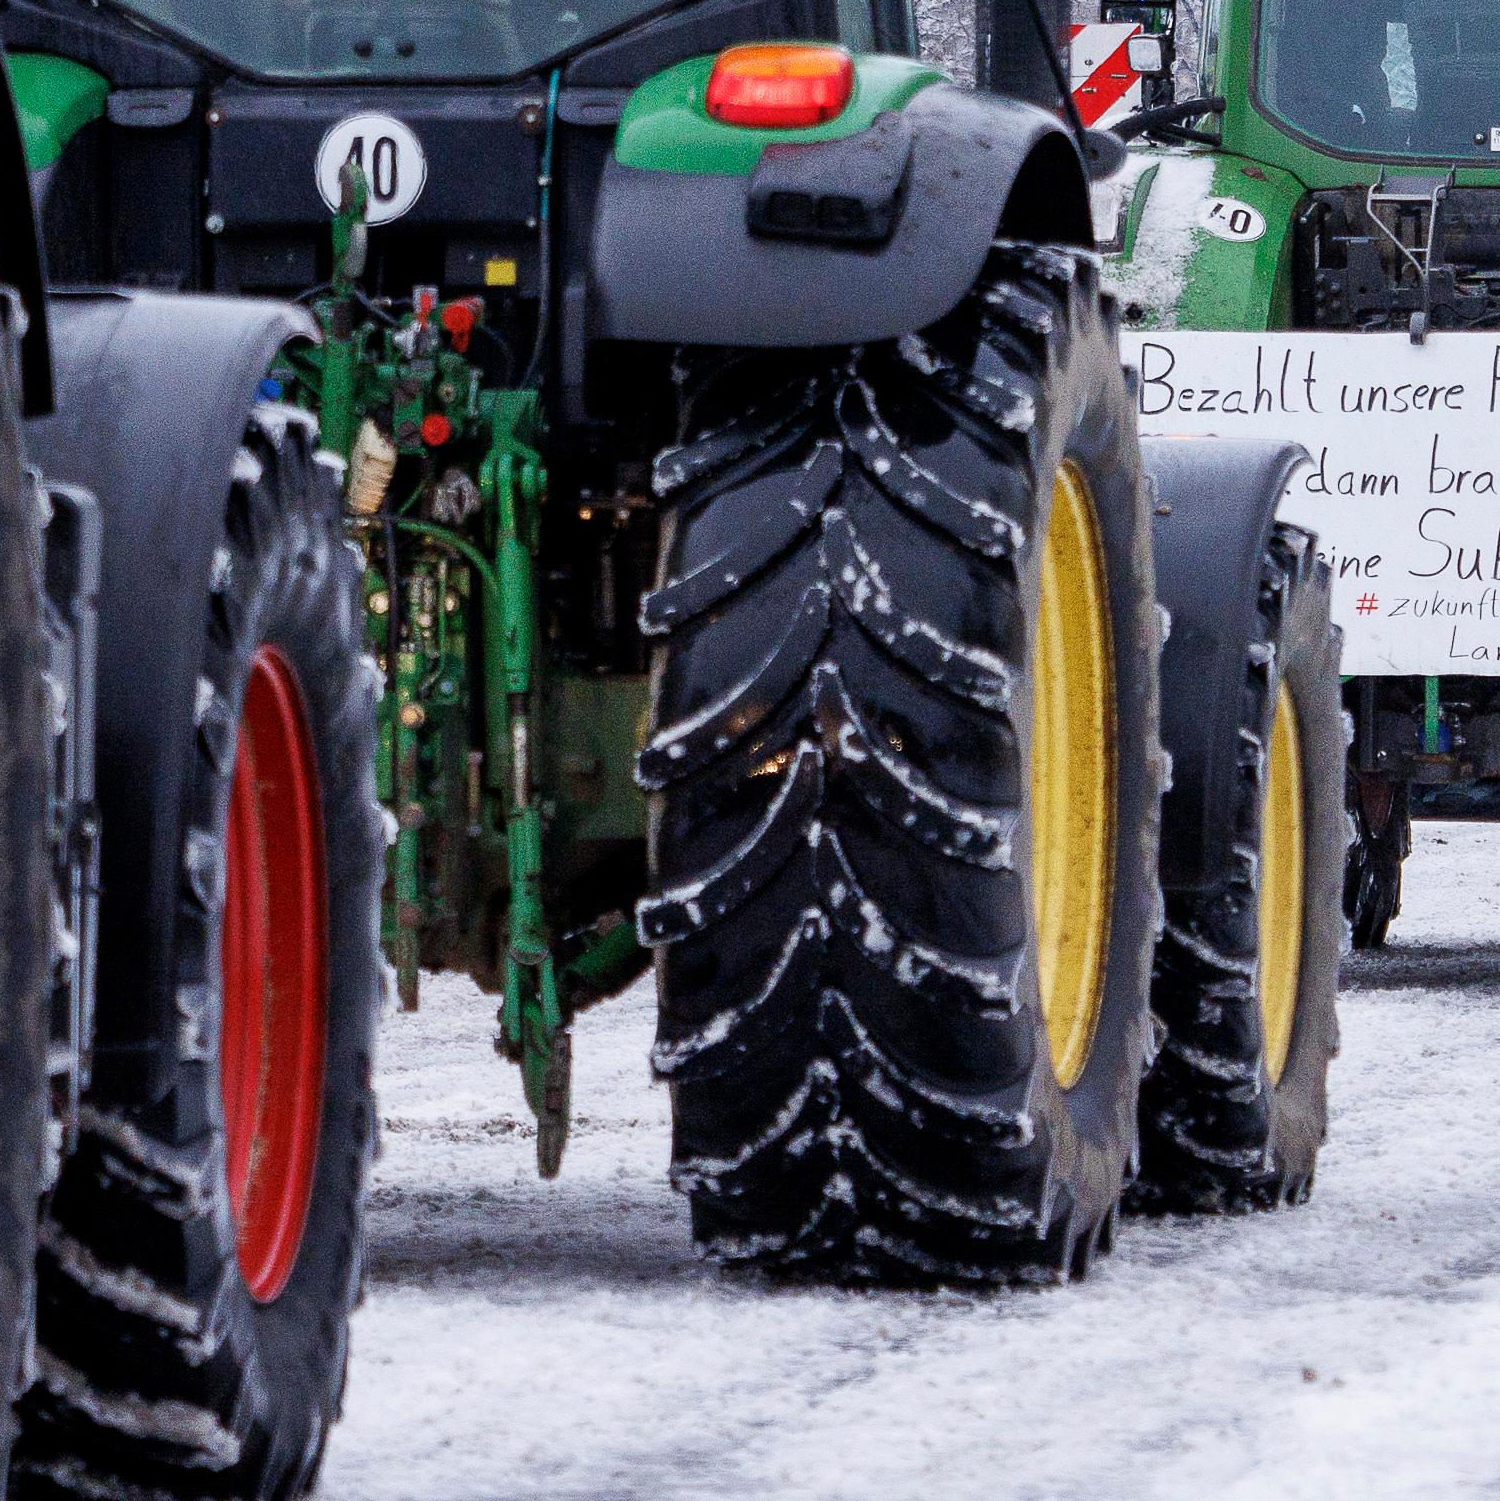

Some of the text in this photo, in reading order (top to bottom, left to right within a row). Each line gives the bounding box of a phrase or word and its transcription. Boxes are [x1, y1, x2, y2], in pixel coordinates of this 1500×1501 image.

[1139, 342, 1320, 416] Bezahlt
[1340, 383, 1465, 413] unsere
[1305, 446, 1399, 496] dann
